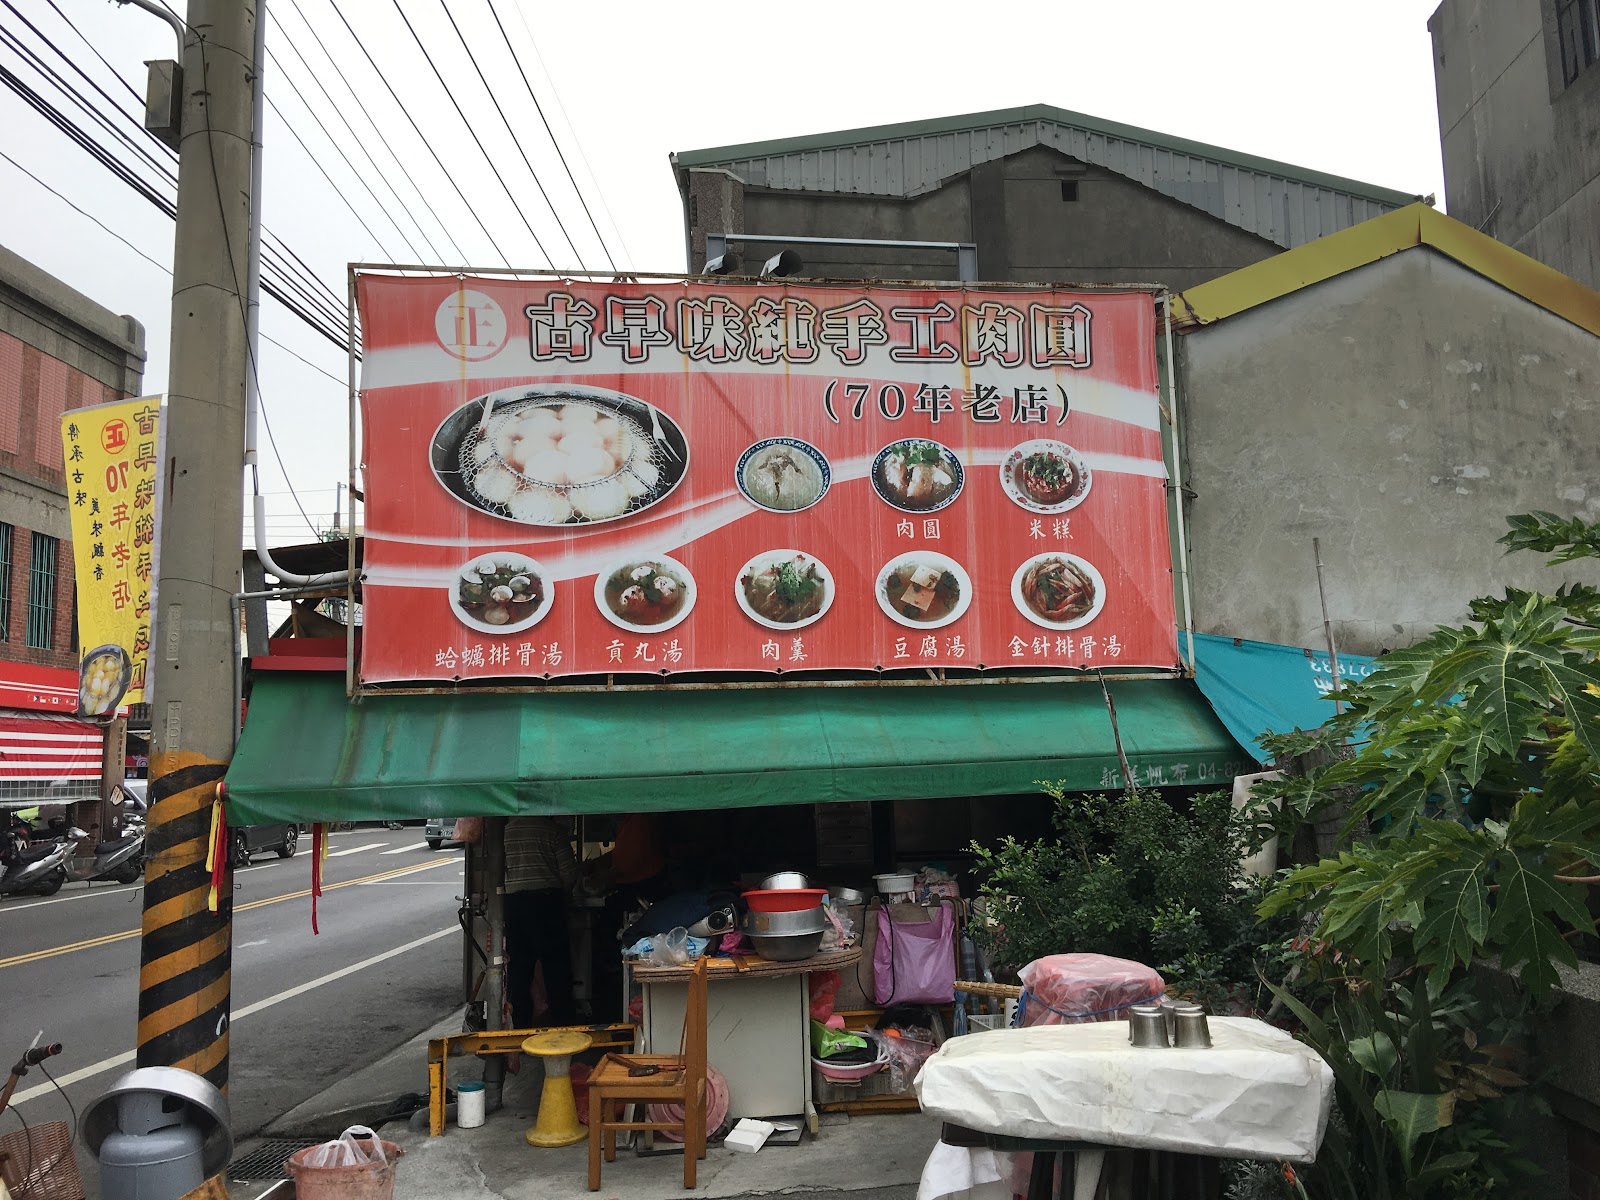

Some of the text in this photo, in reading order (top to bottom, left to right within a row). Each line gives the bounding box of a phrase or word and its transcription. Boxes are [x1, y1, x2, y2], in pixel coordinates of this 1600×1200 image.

[445, 299, 499, 351] 正
[525, 292, 1093, 369] 古早味純手工肉圓
[823, 382, 1072, 425] (70年老店)
[896, 518, 941, 540] 肉圓
[1028, 518, 1074, 541] 米糕
[435, 641, 563, 669] 蛤蠣排骨湯
[606, 638, 684, 664] 貢丸湯
[761, 636, 808, 661] 肉羹
[893, 635, 966, 659] 豆腐湯
[1008, 635, 1122, 659] 金針排骨湯
